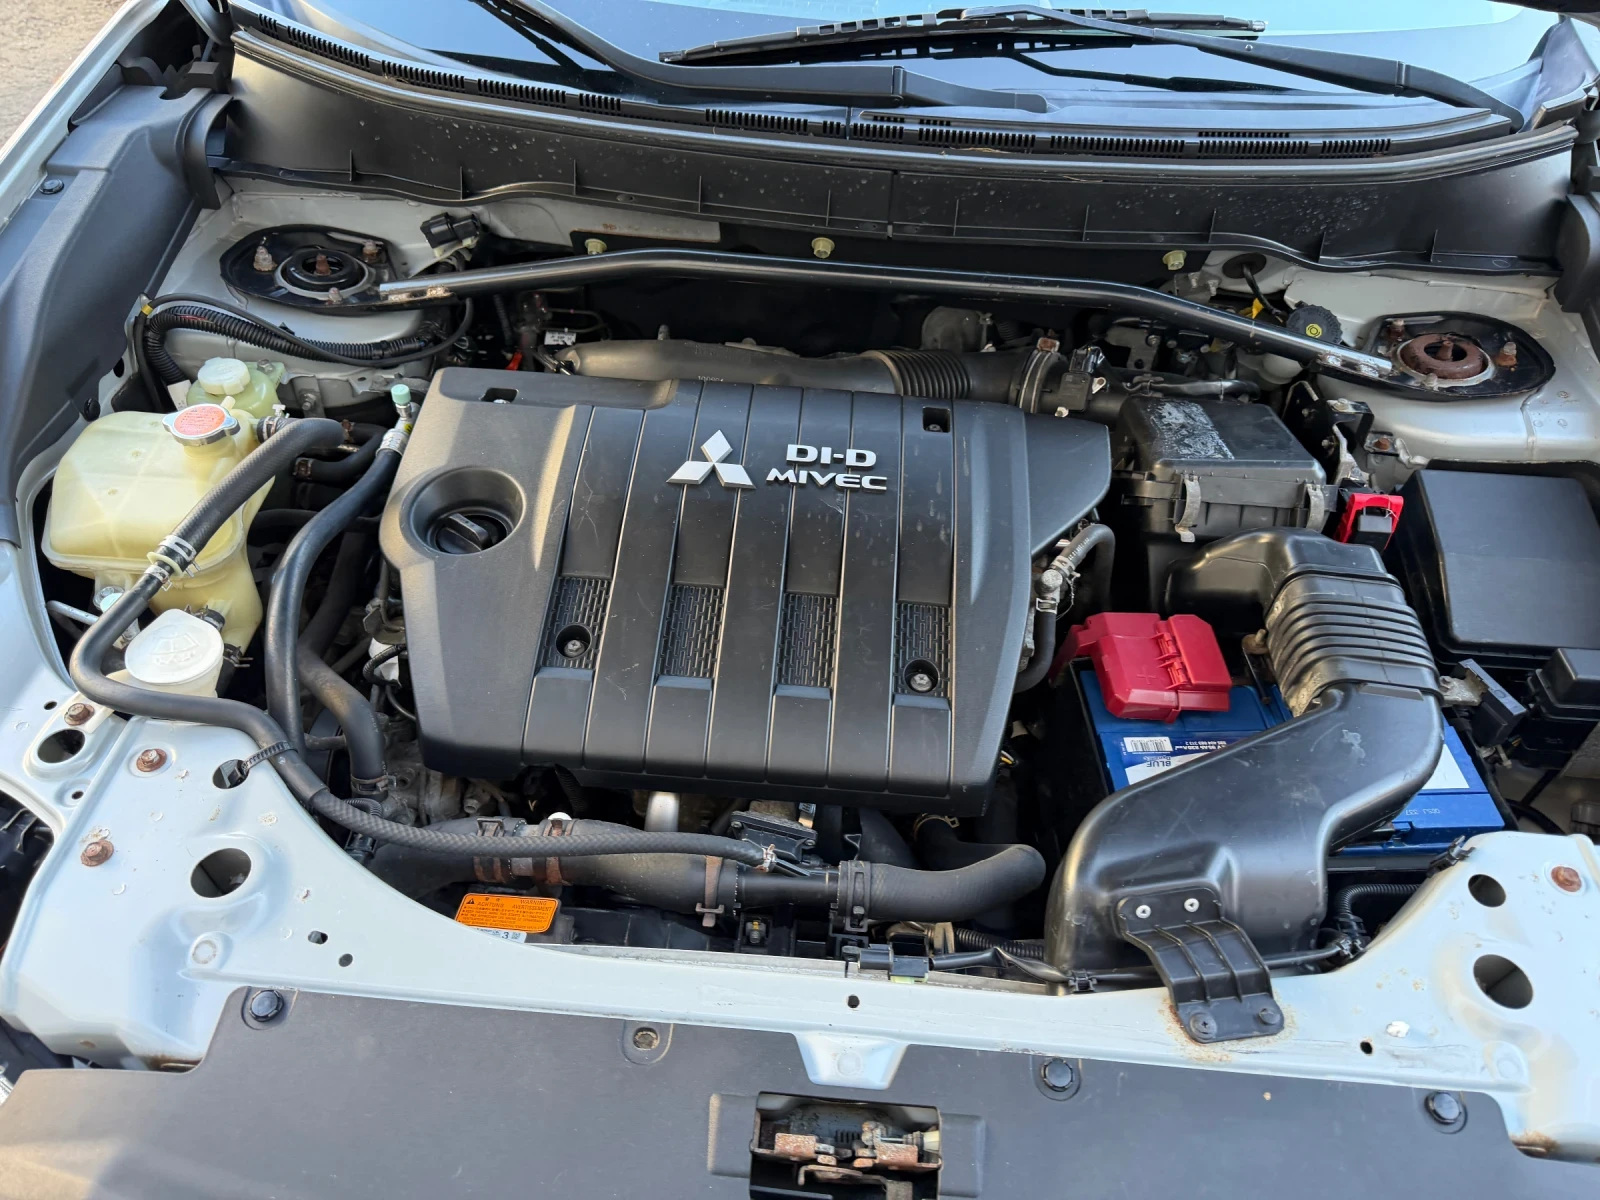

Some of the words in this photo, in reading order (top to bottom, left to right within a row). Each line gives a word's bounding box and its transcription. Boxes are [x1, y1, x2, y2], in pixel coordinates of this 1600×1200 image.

[786, 444, 877, 469] DI-D
[766, 468, 888, 491] MIVEC
[512, 904, 553, 912] AVERTISSEMENT
